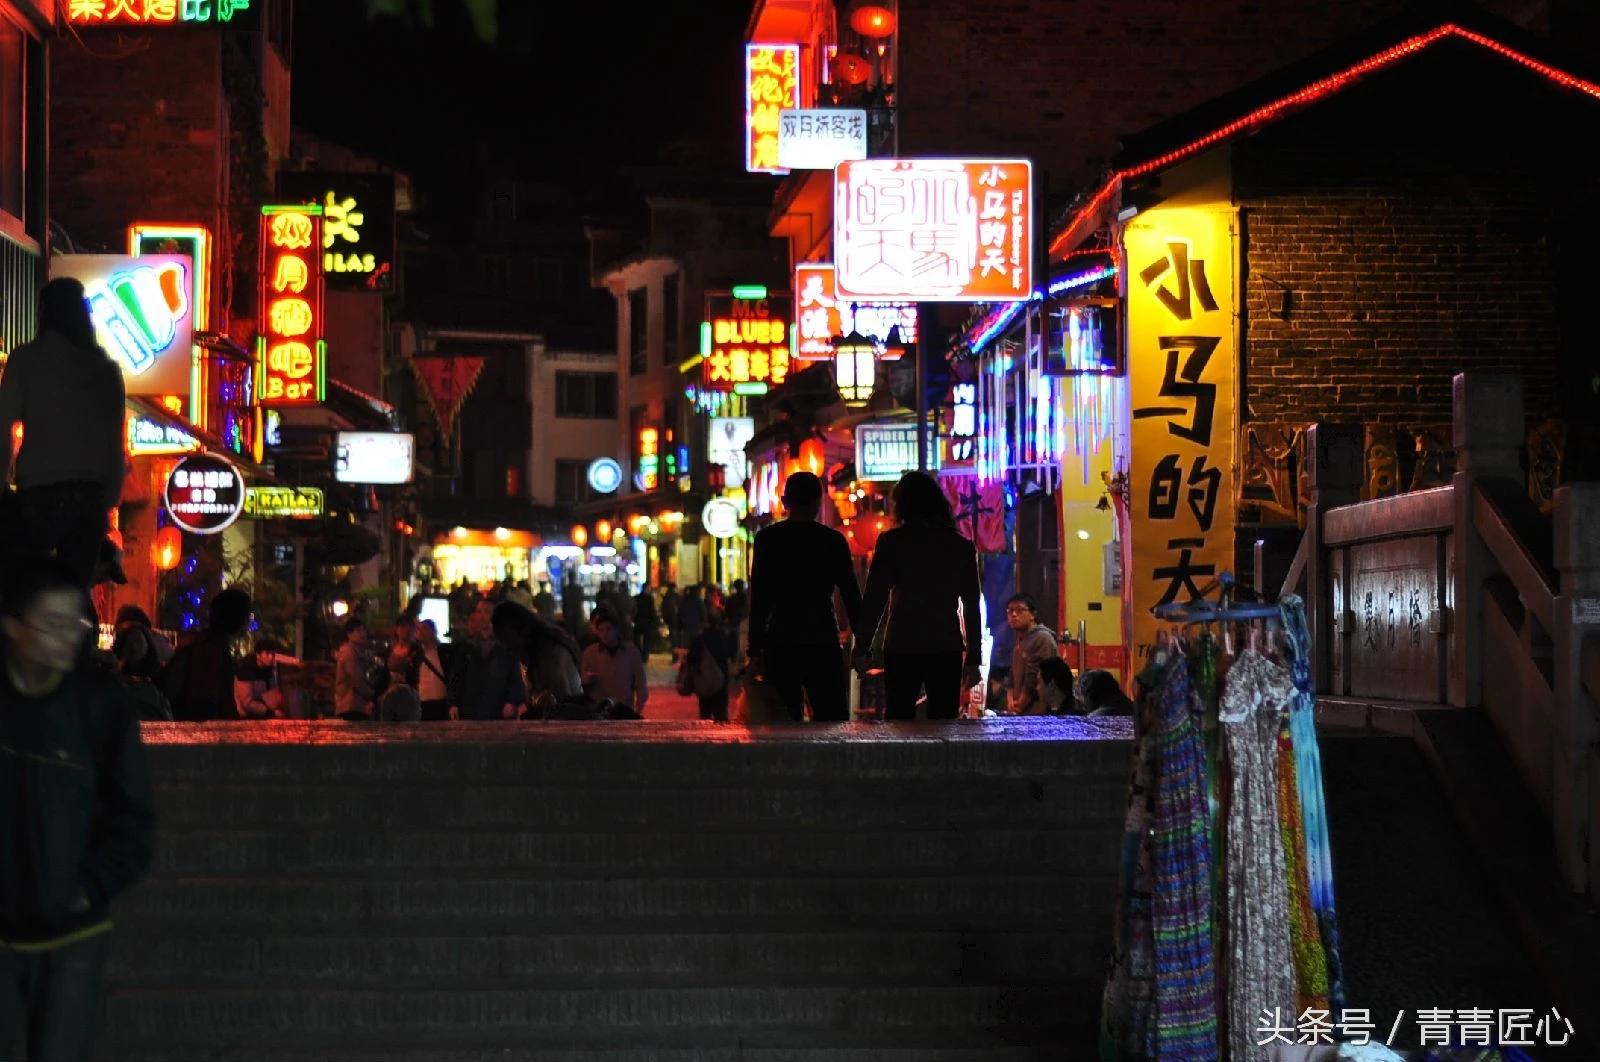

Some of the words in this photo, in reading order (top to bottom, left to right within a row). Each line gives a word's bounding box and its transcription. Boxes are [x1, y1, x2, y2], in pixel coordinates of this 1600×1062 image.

[783, 113, 863, 140] 双月桥客栈
[978, 165, 1008, 278] 小马的天
[714, 319, 785, 344] BLUES
[267, 377, 313, 399] Bar
[864, 430, 904, 442] SPIDER
[906, 430, 932, 442] MN
[1133, 241, 1222, 613] 小马的天
